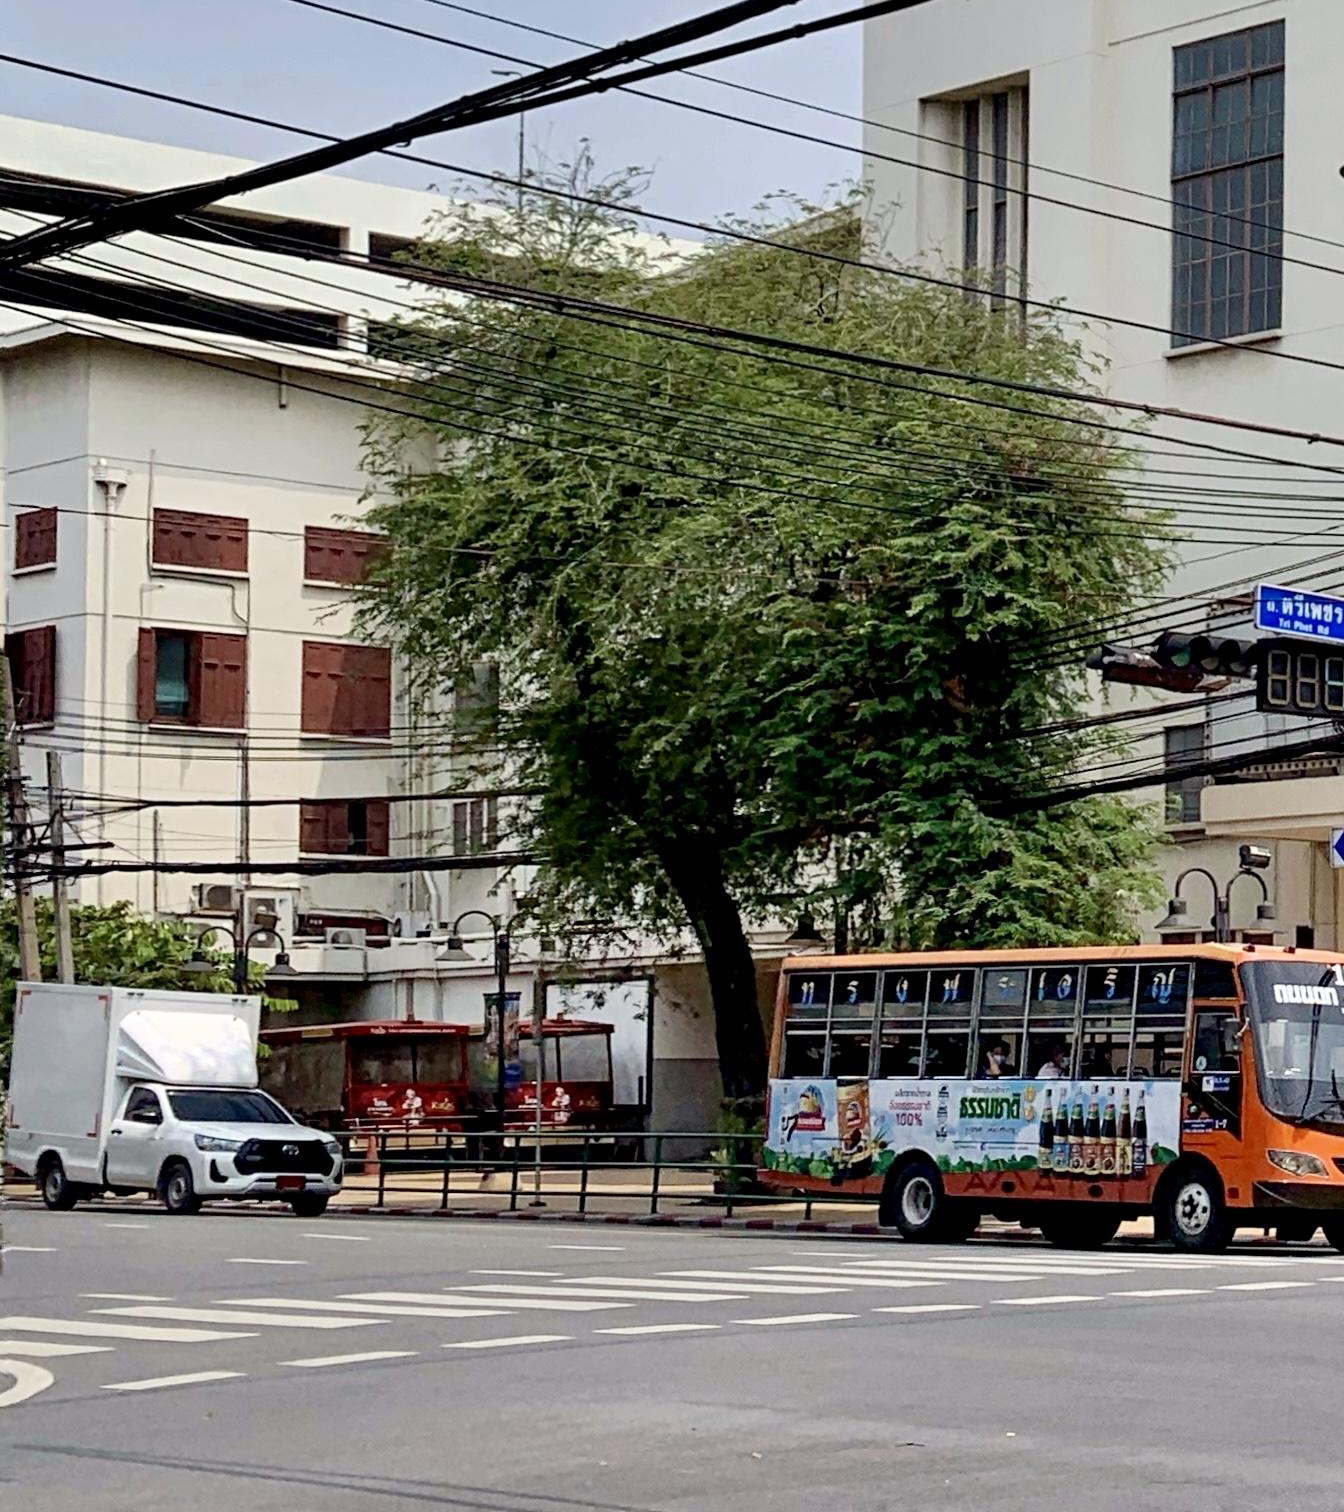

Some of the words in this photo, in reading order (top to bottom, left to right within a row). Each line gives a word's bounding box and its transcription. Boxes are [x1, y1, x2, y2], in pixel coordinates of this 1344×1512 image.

[960, 1093, 1021, 1119] ธรรมชาติ
[896, 1113, 923, 1126] 100%
